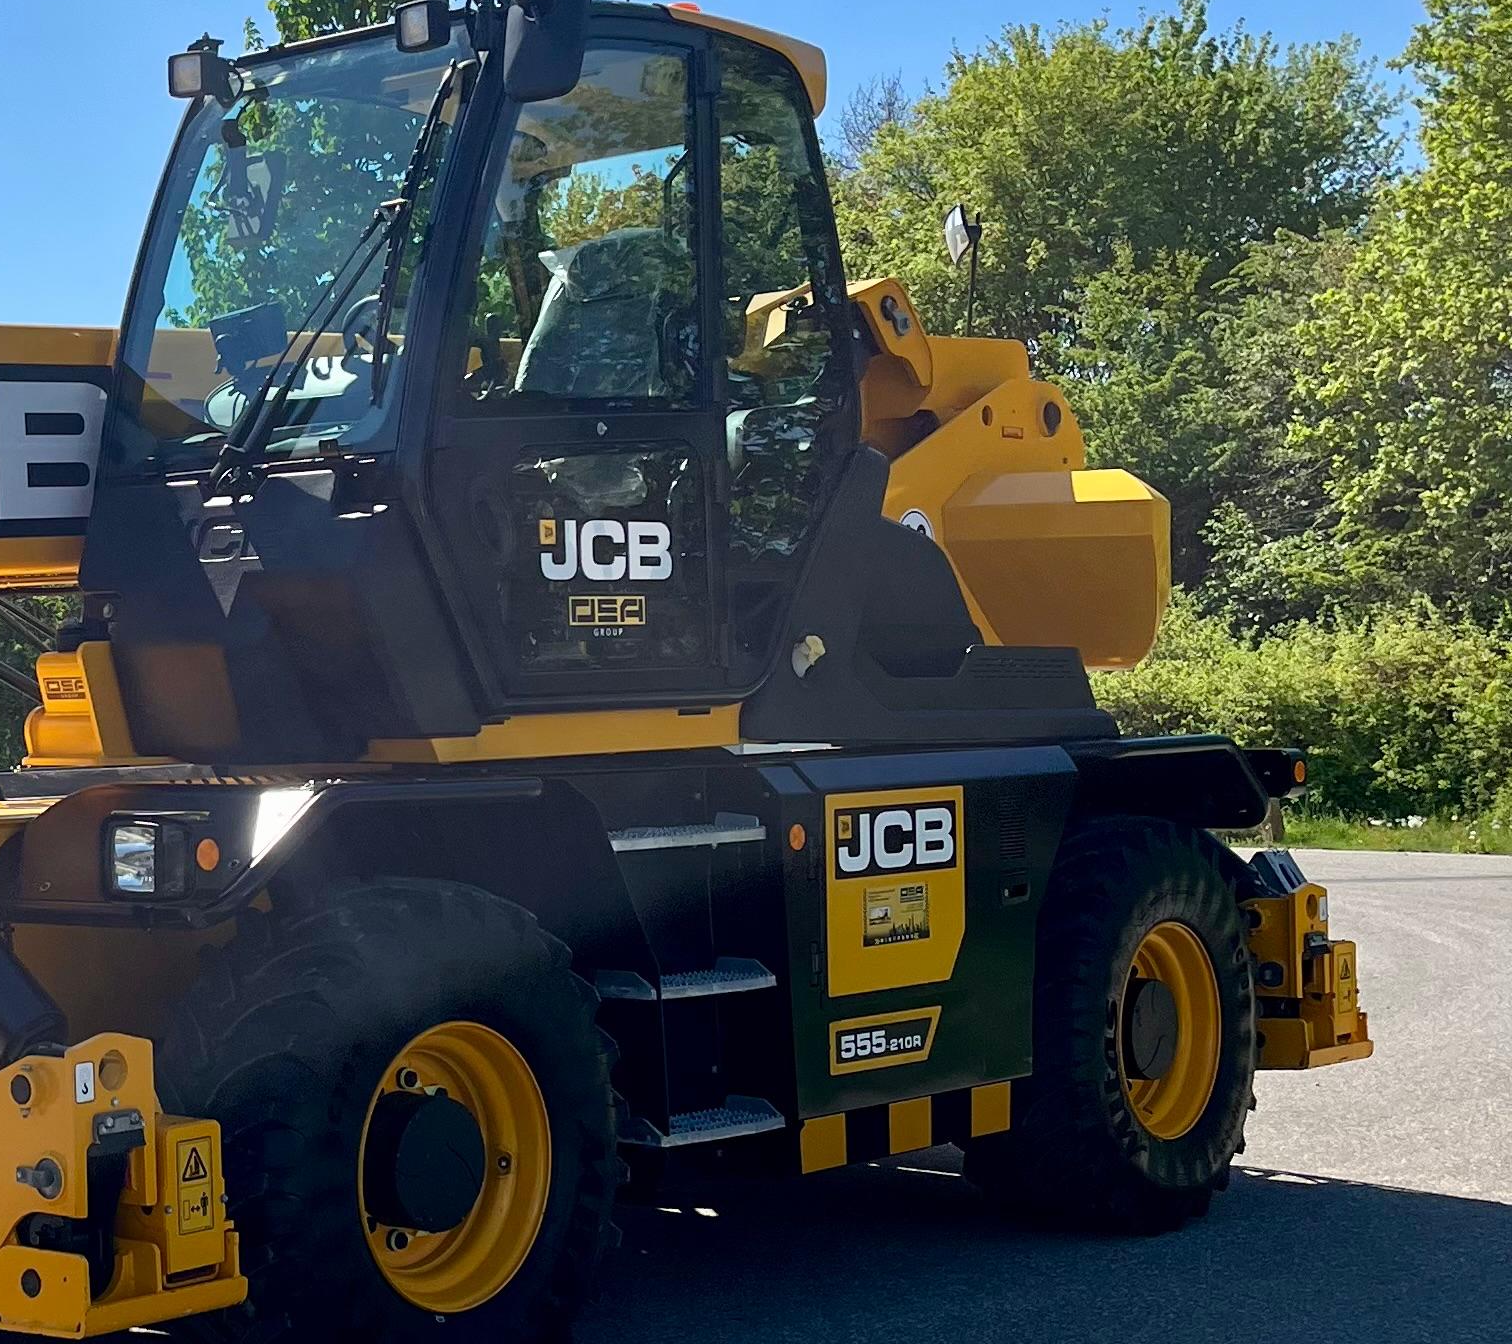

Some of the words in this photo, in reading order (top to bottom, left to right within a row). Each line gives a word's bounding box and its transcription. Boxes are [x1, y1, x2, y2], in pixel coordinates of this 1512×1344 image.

[541, 520, 673, 581] JCB
[593, 628, 624, 637] GROUP
[838, 808, 954, 873] JCB
[840, 1030, 922, 1059] 555-210R
